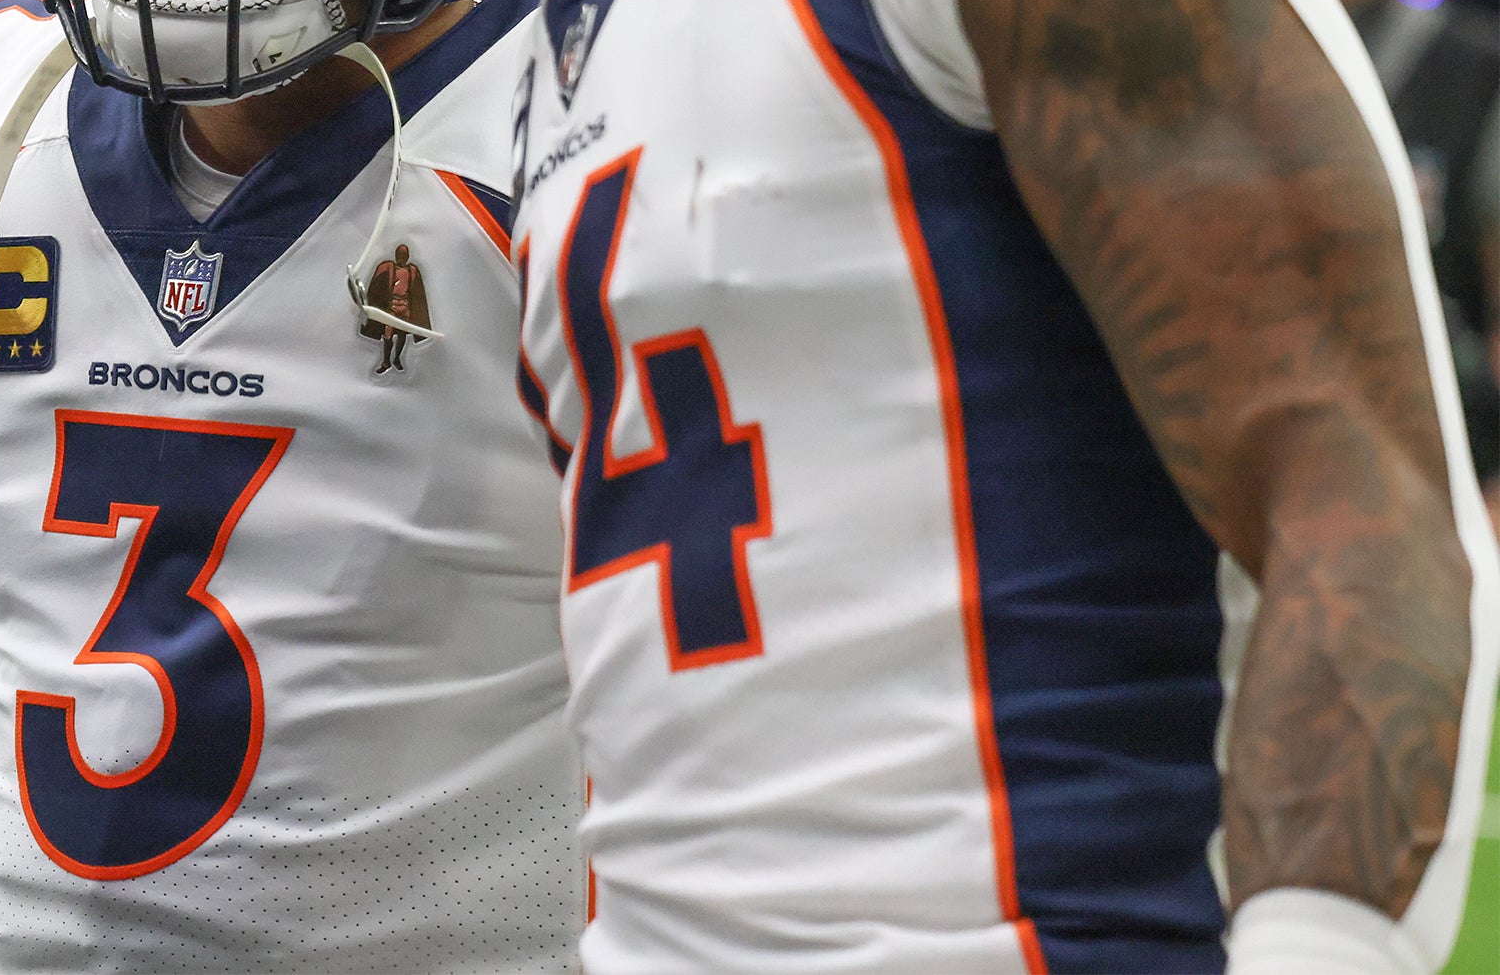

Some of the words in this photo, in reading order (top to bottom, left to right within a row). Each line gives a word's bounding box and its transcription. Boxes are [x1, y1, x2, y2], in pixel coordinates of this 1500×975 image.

[164, 280, 206, 319] NFL
[88, 361, 265, 398] BRONCOS
[14, 408, 297, 882] 3
